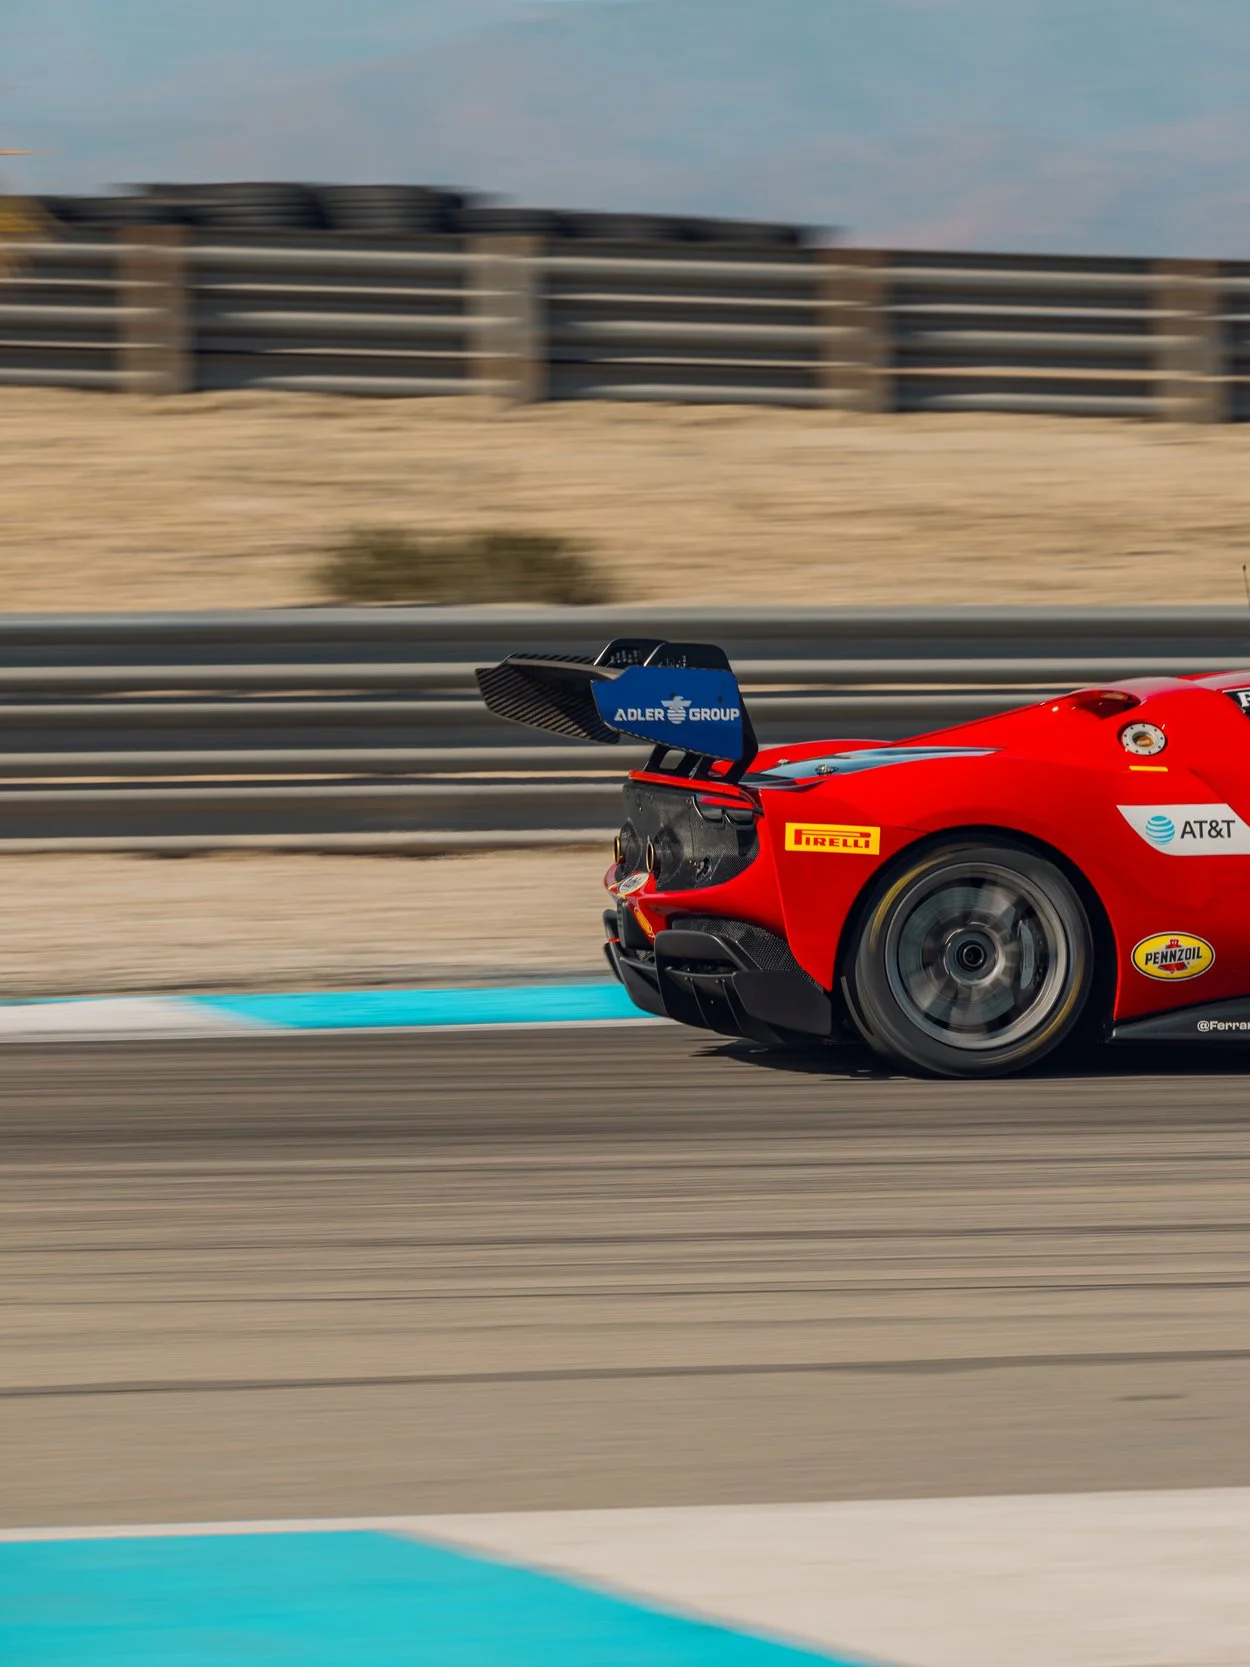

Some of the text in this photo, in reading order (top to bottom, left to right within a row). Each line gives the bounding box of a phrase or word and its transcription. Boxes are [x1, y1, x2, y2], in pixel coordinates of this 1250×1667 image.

[614, 708, 740, 721] ADLER GROUP
[794, 829, 871, 848] PIRELLI
[1181, 820, 1235, 839] AT&T
[1145, 946, 1202, 965] PENNZOIL
